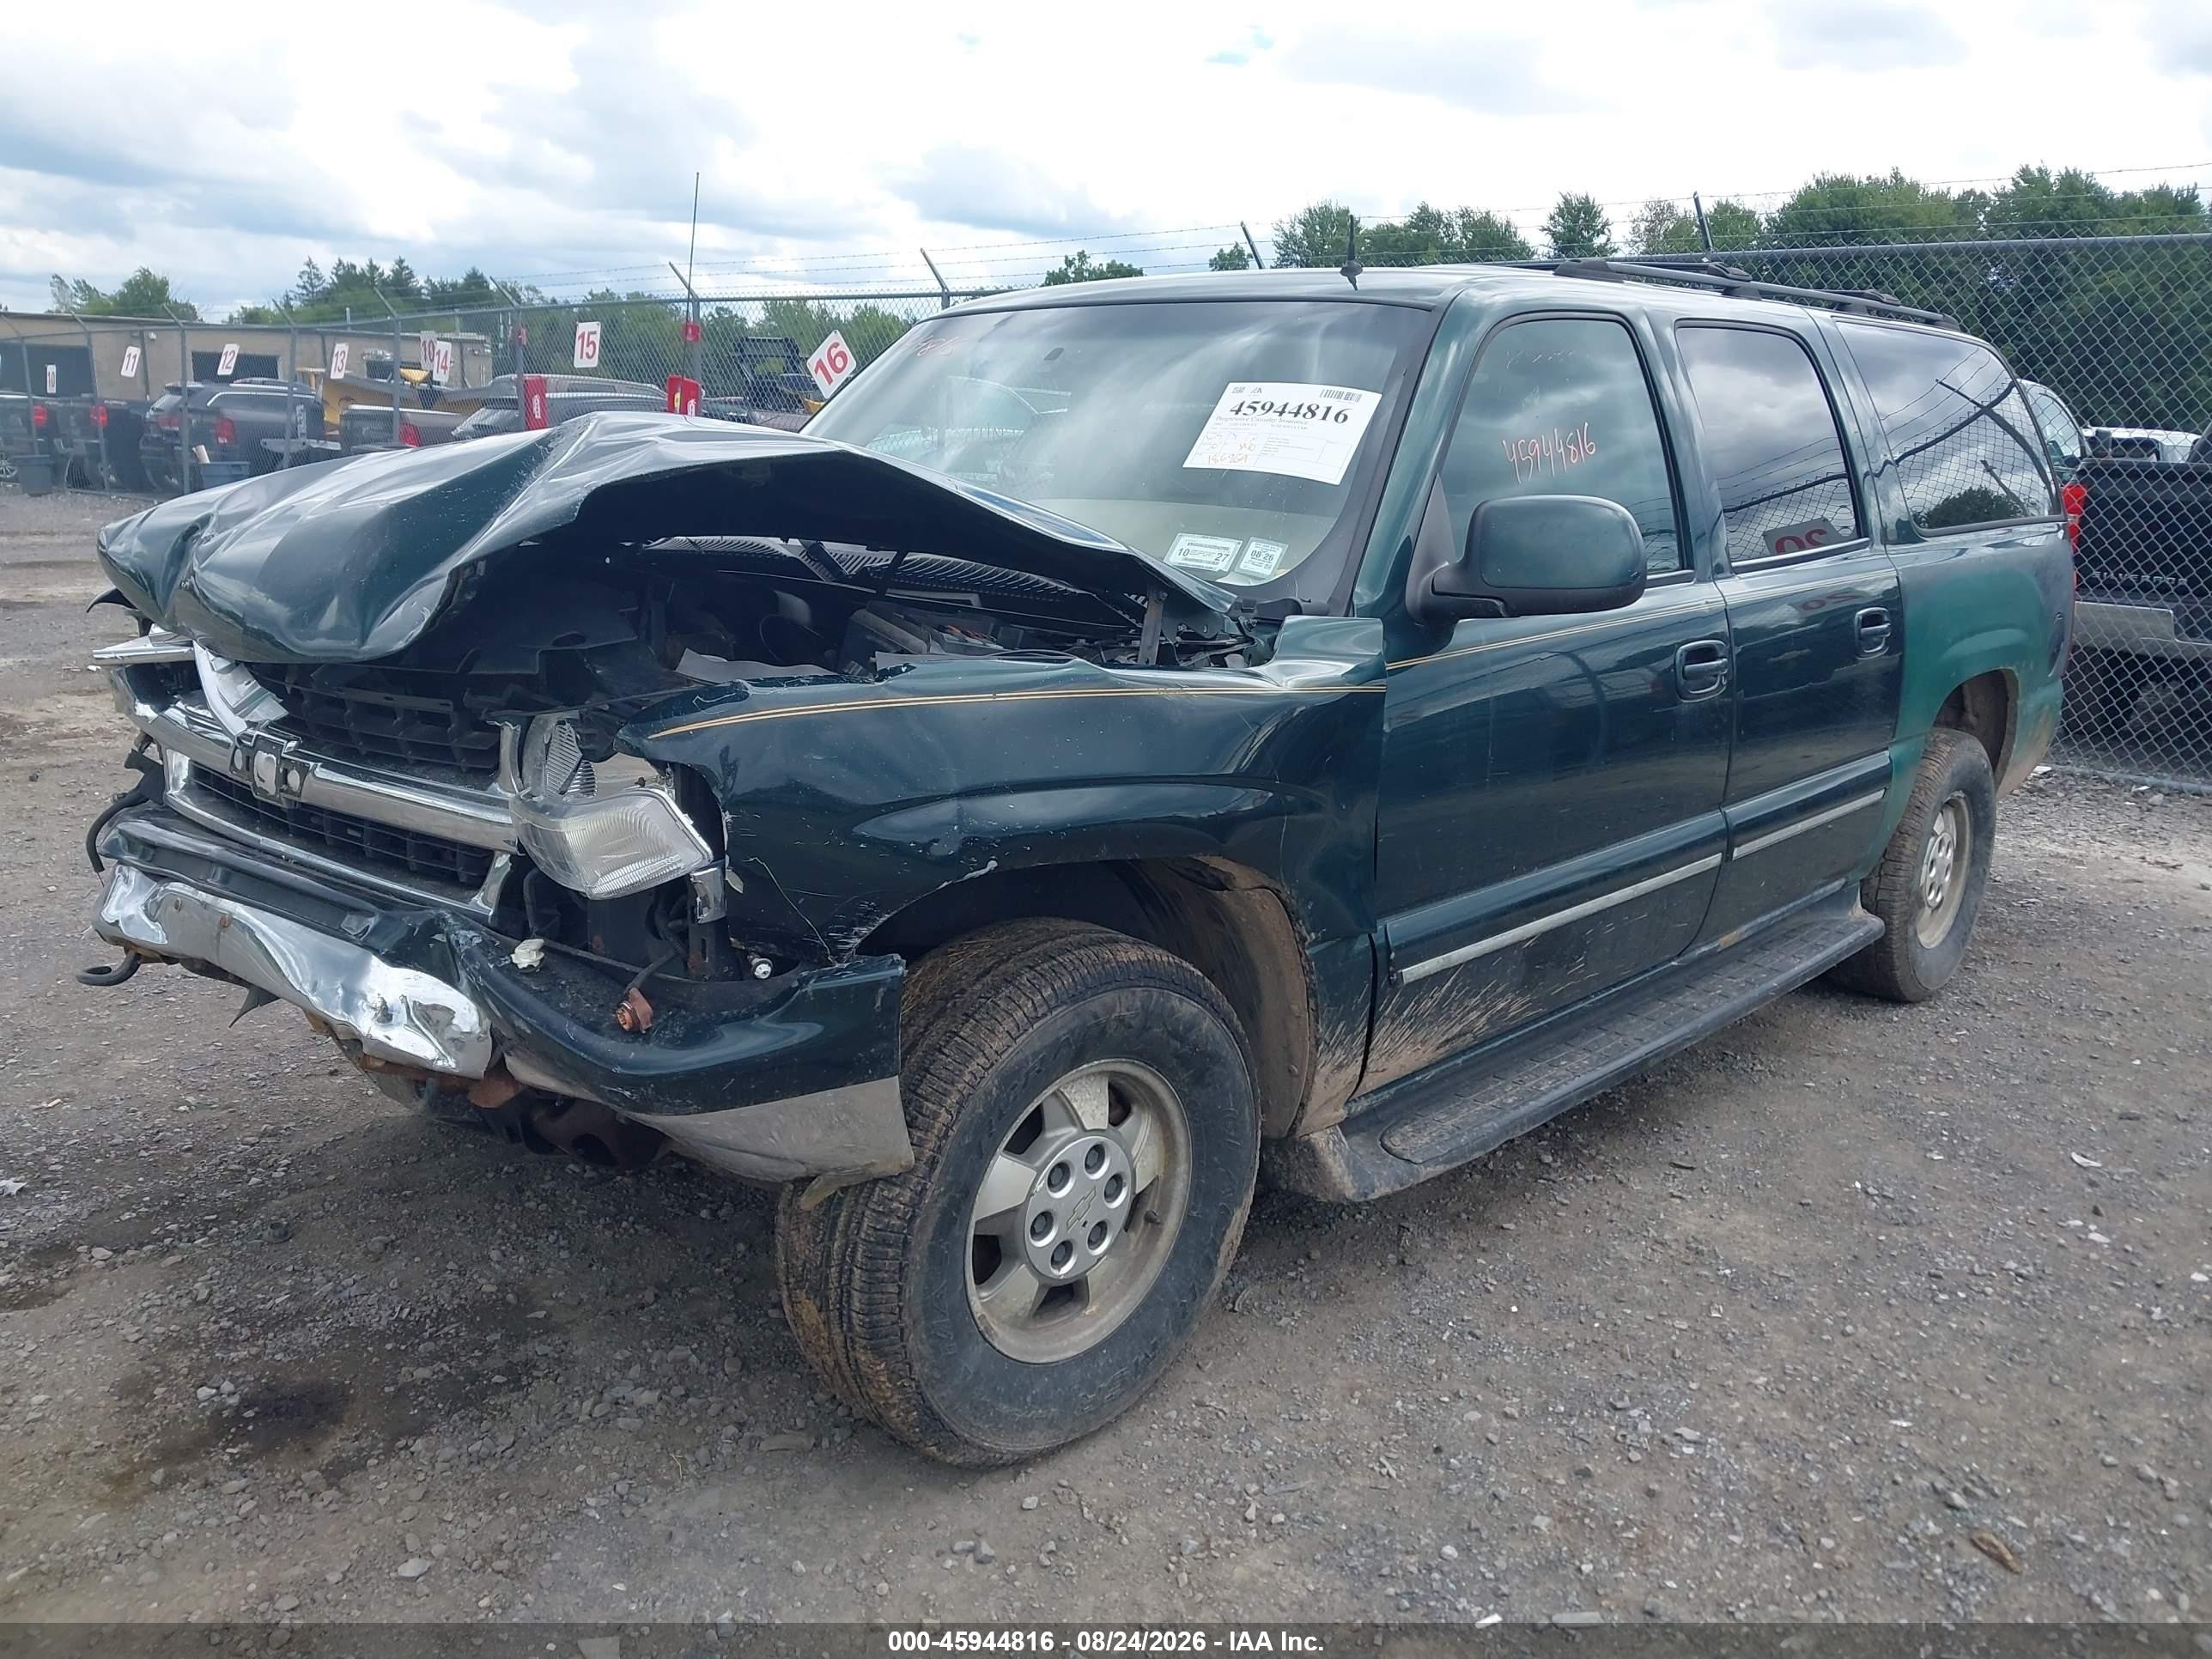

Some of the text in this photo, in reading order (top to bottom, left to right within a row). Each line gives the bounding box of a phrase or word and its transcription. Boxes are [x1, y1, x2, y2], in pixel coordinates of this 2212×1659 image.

[577, 330, 597, 360] 15
[125, 354, 138, 373] 11
[219, 349, 236, 371] 12
[333, 349, 347, 373] 13
[435, 349, 449, 375] 14
[814, 342, 848, 386] 16
[47, 370, 56, 388] 10
[1230, 399, 1354, 424] 45944816
[1503, 422, 1596, 484] 45944816
[1177, 547, 1190, 557] 10
[1214, 552, 1231, 562] 27
